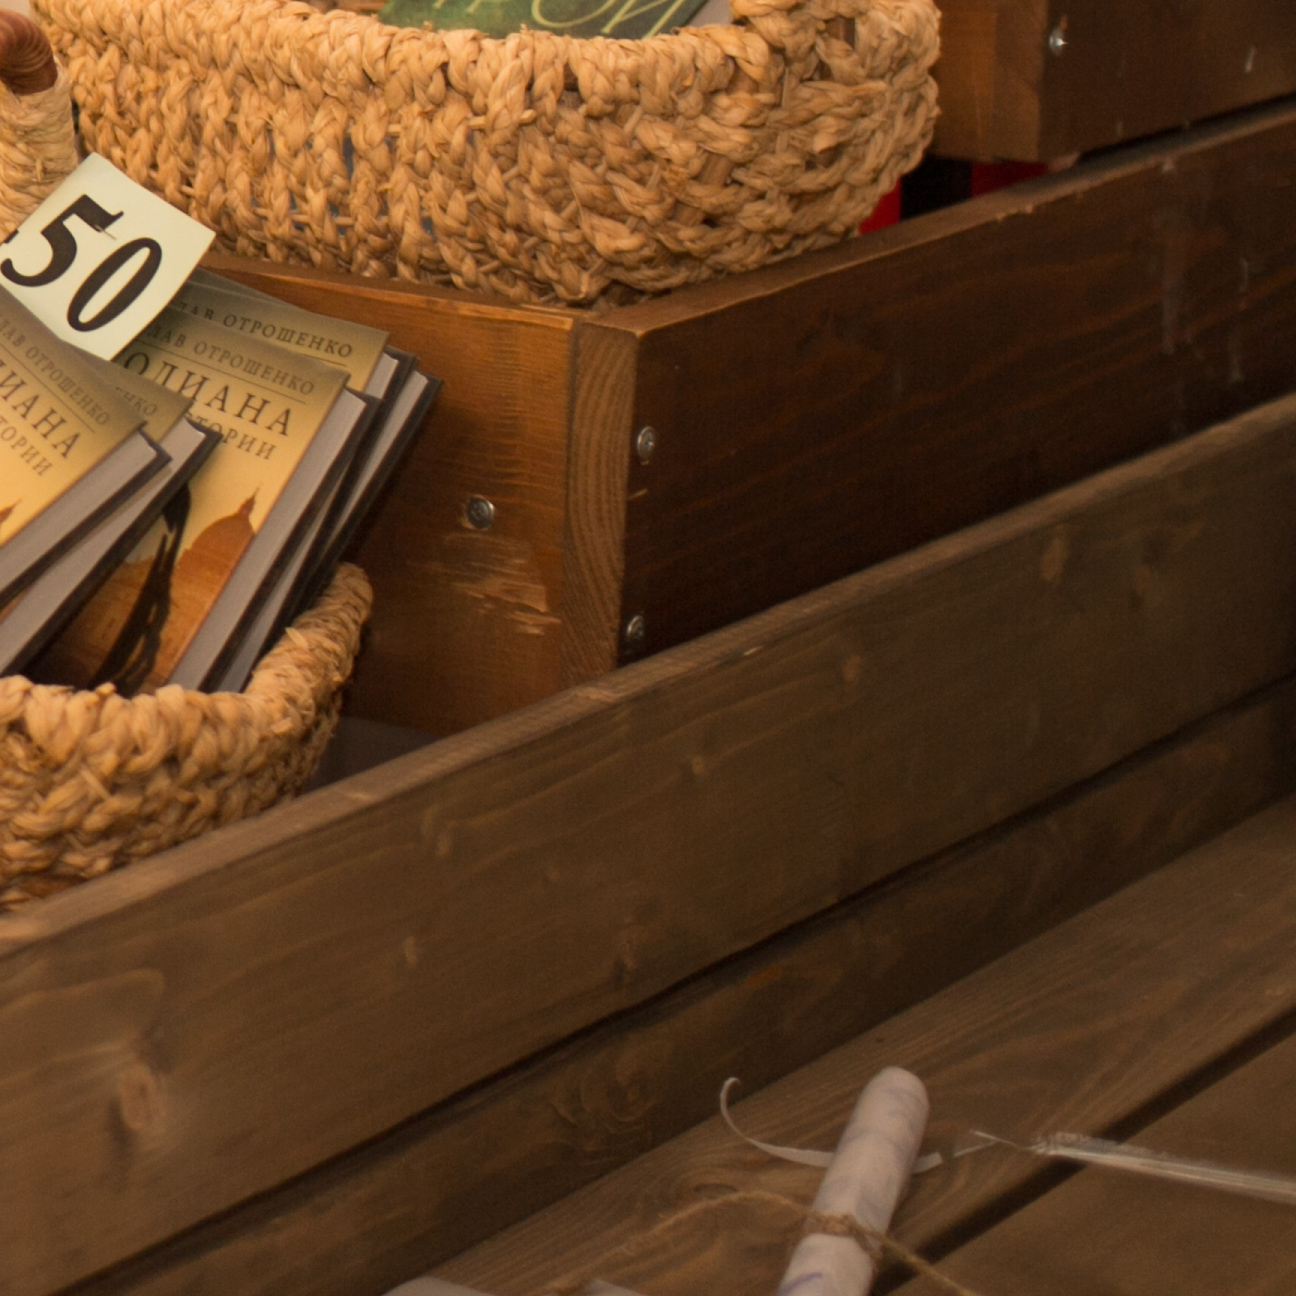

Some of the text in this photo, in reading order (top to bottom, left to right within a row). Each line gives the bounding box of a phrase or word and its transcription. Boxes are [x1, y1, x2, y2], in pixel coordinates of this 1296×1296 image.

[222, 313, 354, 359] ОТРОШЕНКО
[25, 338, 110, 427] ОТРОШЕНКО
[193, 341, 316, 396] ОТРОШЕНКО
